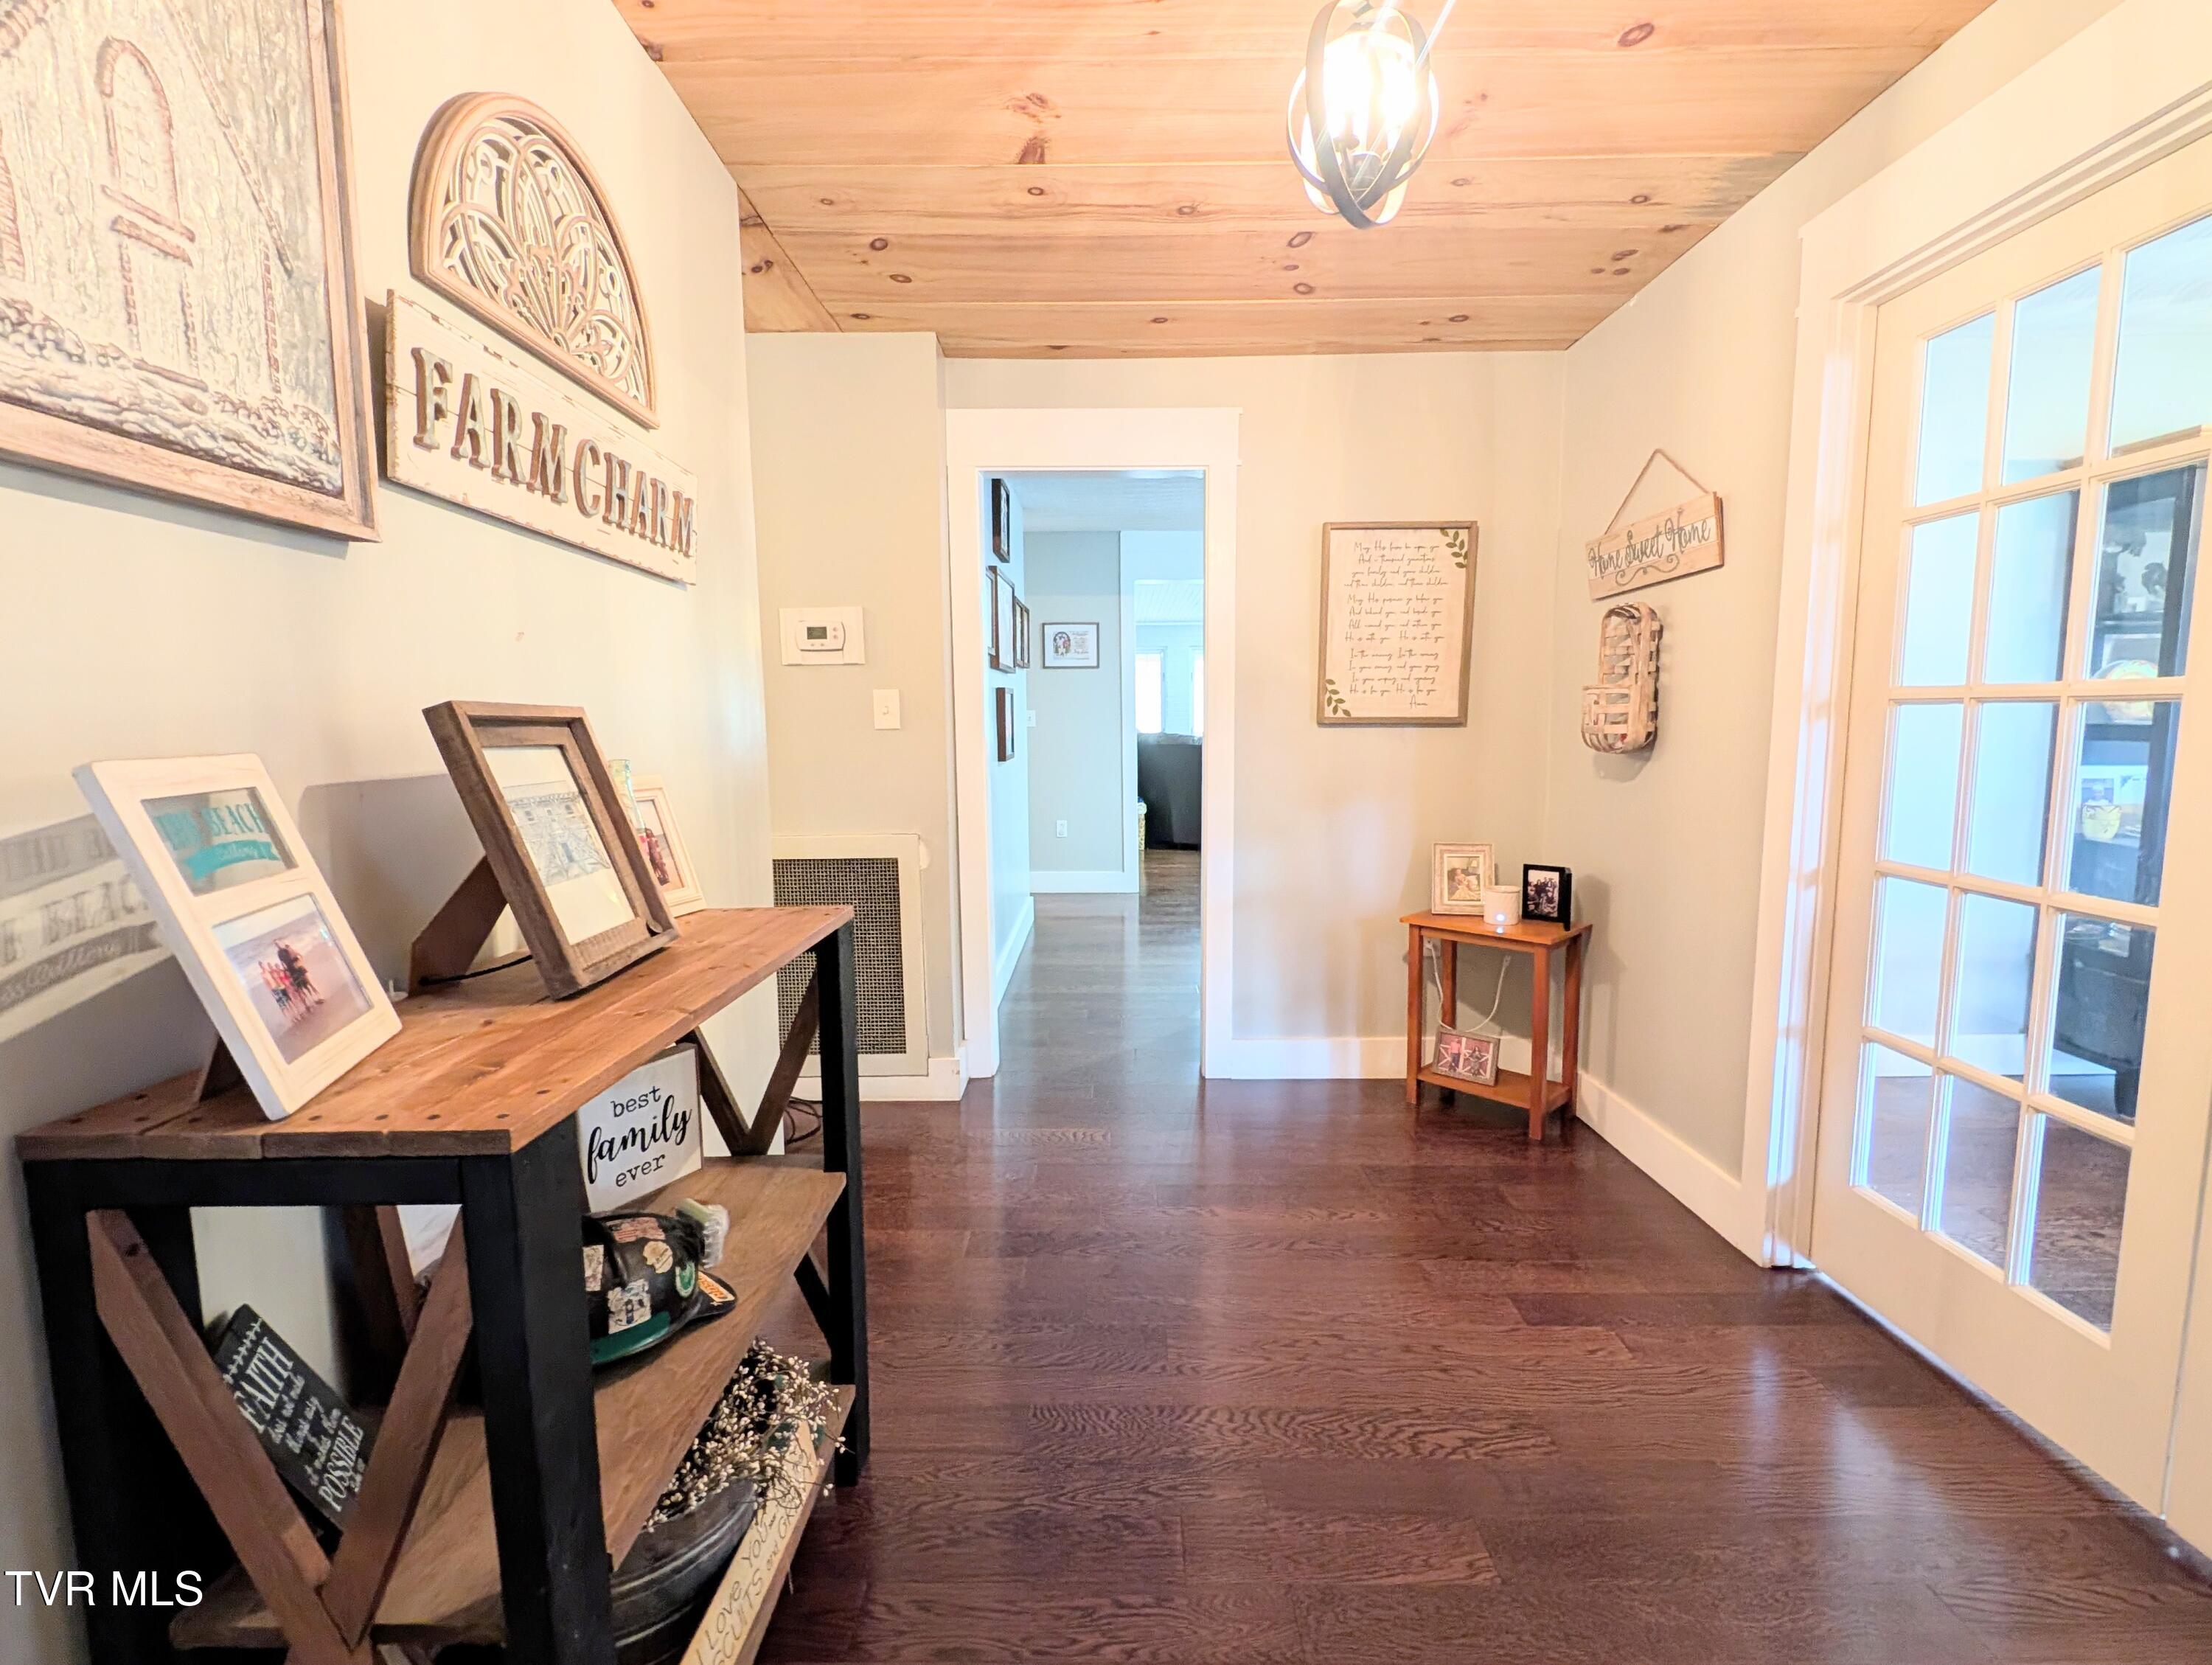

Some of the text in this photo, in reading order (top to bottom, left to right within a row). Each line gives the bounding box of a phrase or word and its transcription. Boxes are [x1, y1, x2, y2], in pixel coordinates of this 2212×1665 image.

[411, 347, 694, 557] FARM CHARM
[1587, 507, 1711, 580] Home Sweet Home
[587, 1094, 693, 1185] family
[611, 1085, 661, 1118] best
[615, 1153, 666, 1188] ever
[233, 1336, 293, 1434] FAITH
[318, 1415, 364, 1513] POSSIBLE
